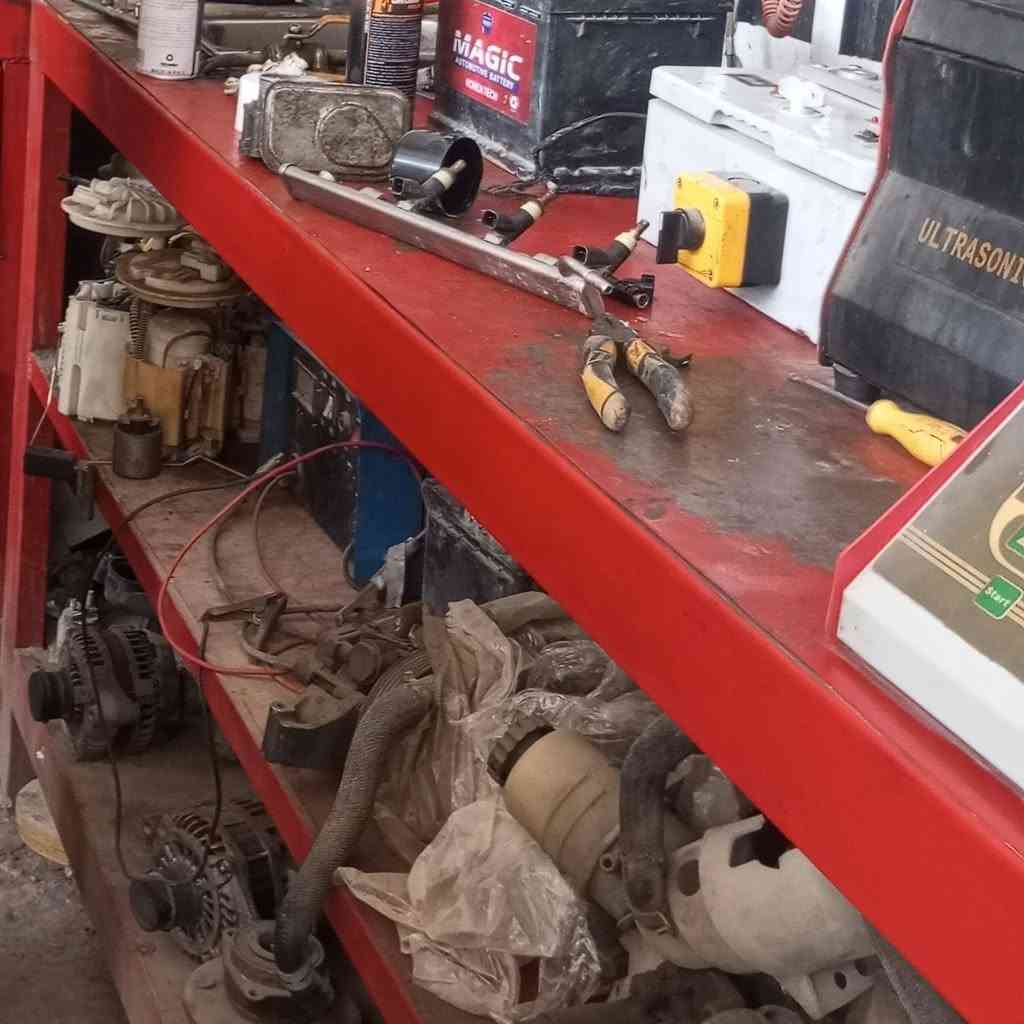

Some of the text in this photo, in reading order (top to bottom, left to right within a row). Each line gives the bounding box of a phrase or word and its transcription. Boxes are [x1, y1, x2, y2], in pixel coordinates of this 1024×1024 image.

[489, 71, 515, 90] BATTERY
[918, 217, 1024, 289] ULTRASONI
[984, 586, 1011, 608] Start
